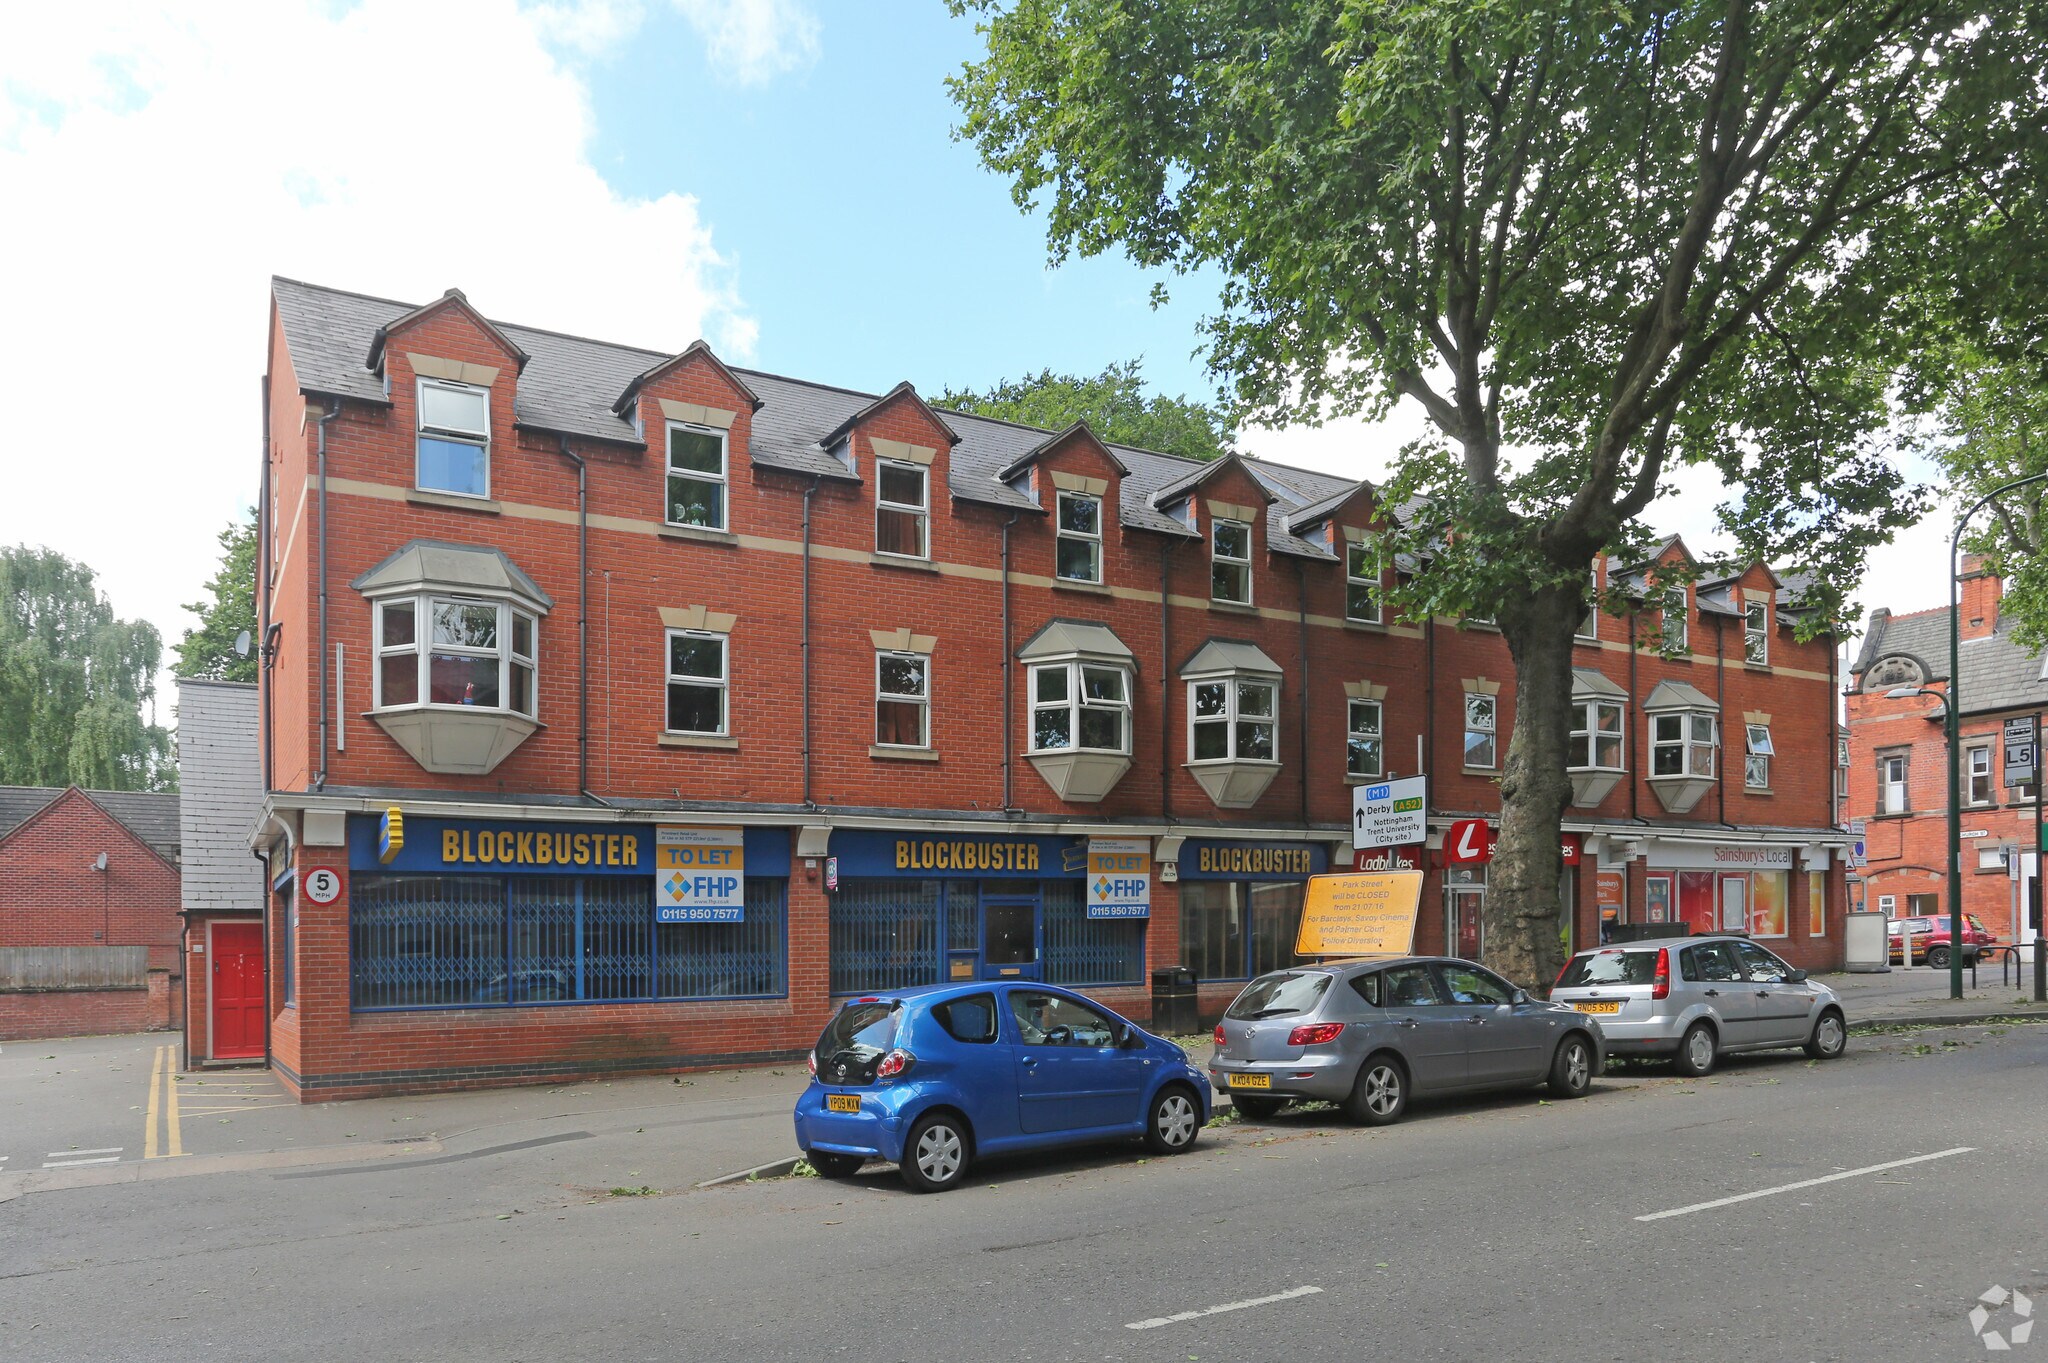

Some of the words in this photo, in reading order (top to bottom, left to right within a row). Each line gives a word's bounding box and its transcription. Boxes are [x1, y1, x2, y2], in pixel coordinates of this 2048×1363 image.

[2007, 748, 2030, 764] L5
[1367, 786, 1389, 799] (M1)
[1367, 804, 1391, 815] Derby
[1394, 798, 1422, 812] (A52)
[1373, 816, 1414, 826] Nottingham
[1366, 828, 1384, 836] Trent
[1386, 823, 1420, 833] University
[1375, 835, 1393, 843] (City
[1395, 832, 1412, 841] site)
[443, 829, 637, 865] BLOCKBUSTER
[667, 848, 694, 864] TO
[699, 849, 733, 864] LET
[896, 841, 1039, 870] BLOCKBUSTER
[1200, 847, 1311, 873] BLOCKBUSTER
[1714, 846, 1765, 866] Sainsbury's
[1766, 848, 1791, 863] Local
[1097, 857, 1115, 870] TO
[1118, 857, 1143, 870] LET
[1360, 854, 1414, 871] Ladbrkes
[316, 873, 330, 891] 5
[694, 876, 738, 897] FHP
[1114, 879, 1146, 897] FHP
[1360, 880, 1384, 888] Street
[1356, 891, 1390, 899] CLOSED
[662, 909, 687, 919] 0115
[689, 909, 711, 919] 950
[713, 909, 739, 919] 7577
[1091, 907, 1110, 916] 0115
[1111, 907, 1127, 915] 950
[1127, 906, 1146, 915] 7577
[1307, 915, 1319, 923] For
[1355, 914, 1378, 923] Savoy
[1380, 913, 1409, 921] Cinema
[1335, 926, 1362, 934] Palmer
[1363, 925, 1385, 933] Court
[1347, 936, 1383, 944] Diversion
[1577, 1003, 1597, 1012] BN05
[1599, 1003, 1615, 1012] SYS
[1251, 1074, 1267, 1086] GZE
[829, 1096, 846, 1109] YP09
